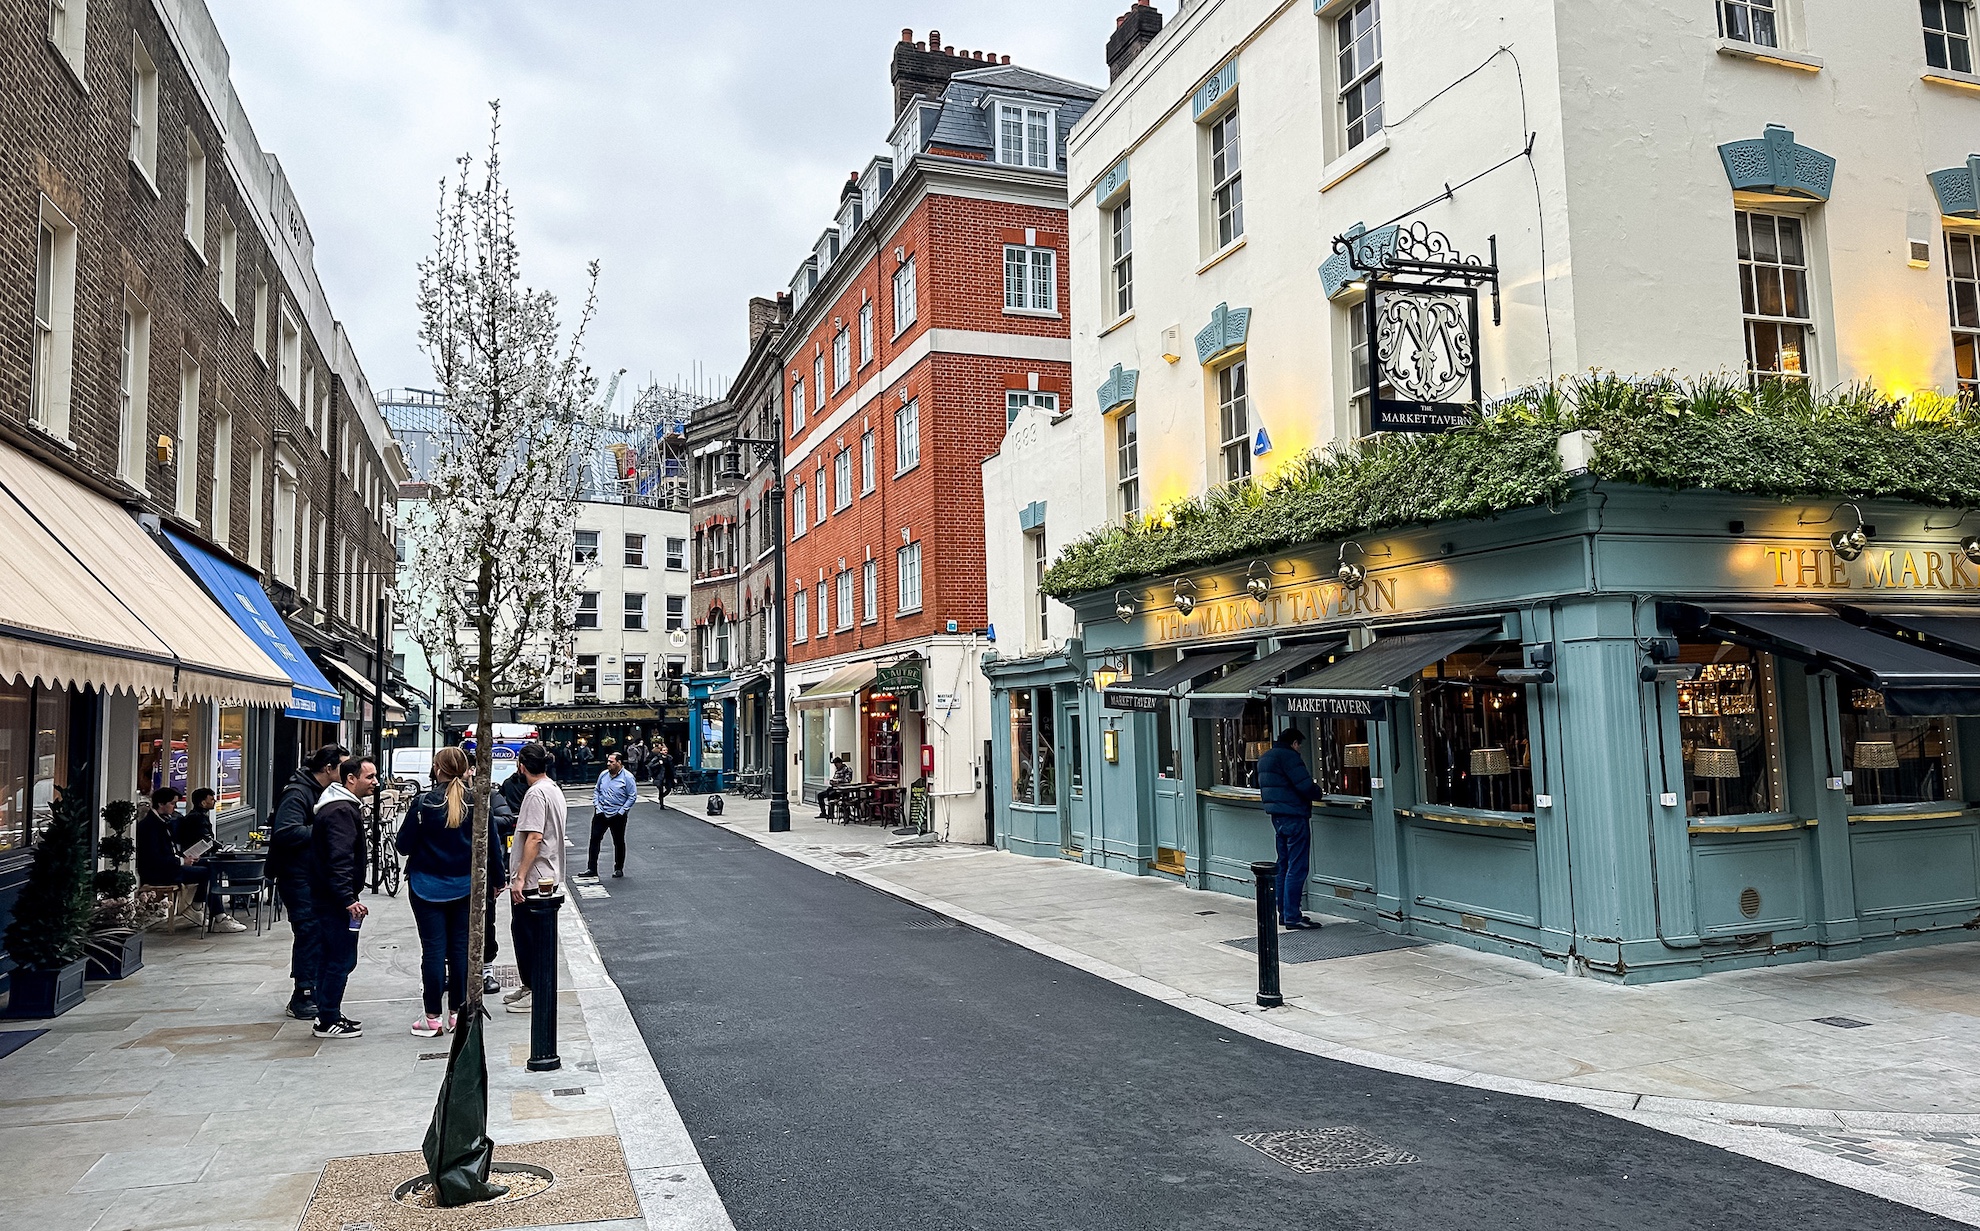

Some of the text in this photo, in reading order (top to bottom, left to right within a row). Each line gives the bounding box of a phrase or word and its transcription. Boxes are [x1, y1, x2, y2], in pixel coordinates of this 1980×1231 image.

[1381, 412, 1473, 426] MARKET TAVERN
[1764, 545, 1980, 590] THE MARK
[1157, 577, 1398, 641] THE MARKET TAVERN
[881, 669, 919, 680] L'AUTRE
[1110, 695, 1158, 709] MARKET TAVERN
[1287, 697, 1372, 715] MARKET TAVERN
[556, 711, 574, 720] THE
[605, 710, 629, 718] ARMS
